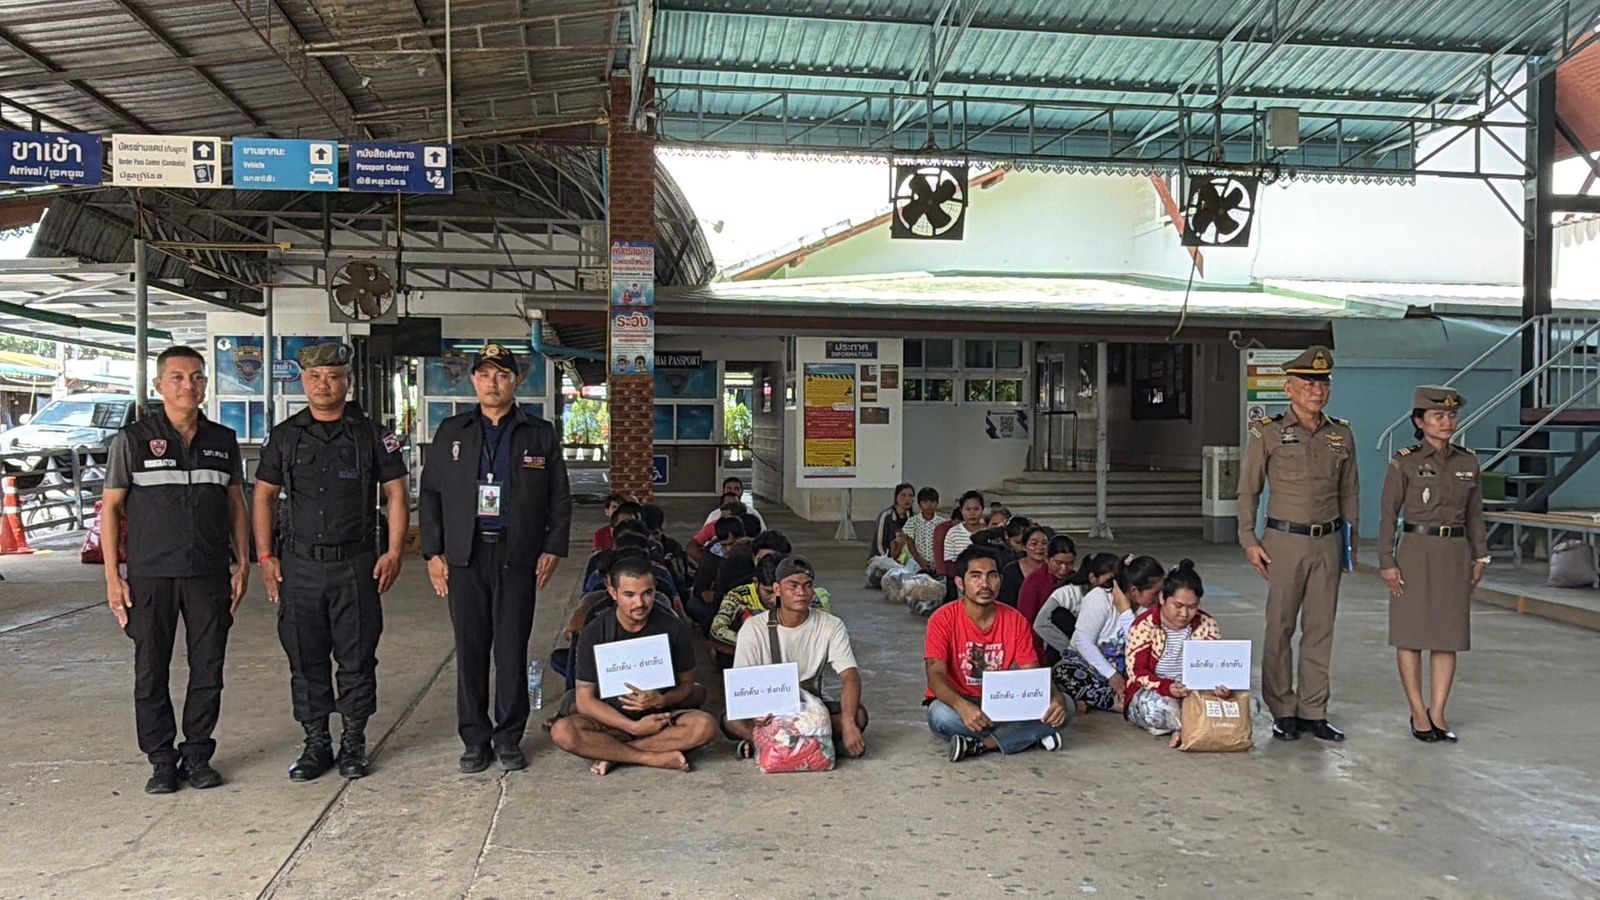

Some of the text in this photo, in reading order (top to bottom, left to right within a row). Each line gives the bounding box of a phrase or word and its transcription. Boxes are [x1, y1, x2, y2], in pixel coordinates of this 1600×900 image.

[12, 137, 83, 163] ขาเข้า
[118, 142, 163, 152] บัตรผ่านแดน
[356, 148, 415, 159] หนังสือเดินทาง
[9, 165, 42, 176] Arrival
[243, 161, 265, 169] Vehicle
[356, 163, 410, 172] Passport Control
[617, 312, 649, 327] ระวัง
[835, 343, 869, 351] ประกาศ
[654, 355, 700, 366] HAI PASSPORT
